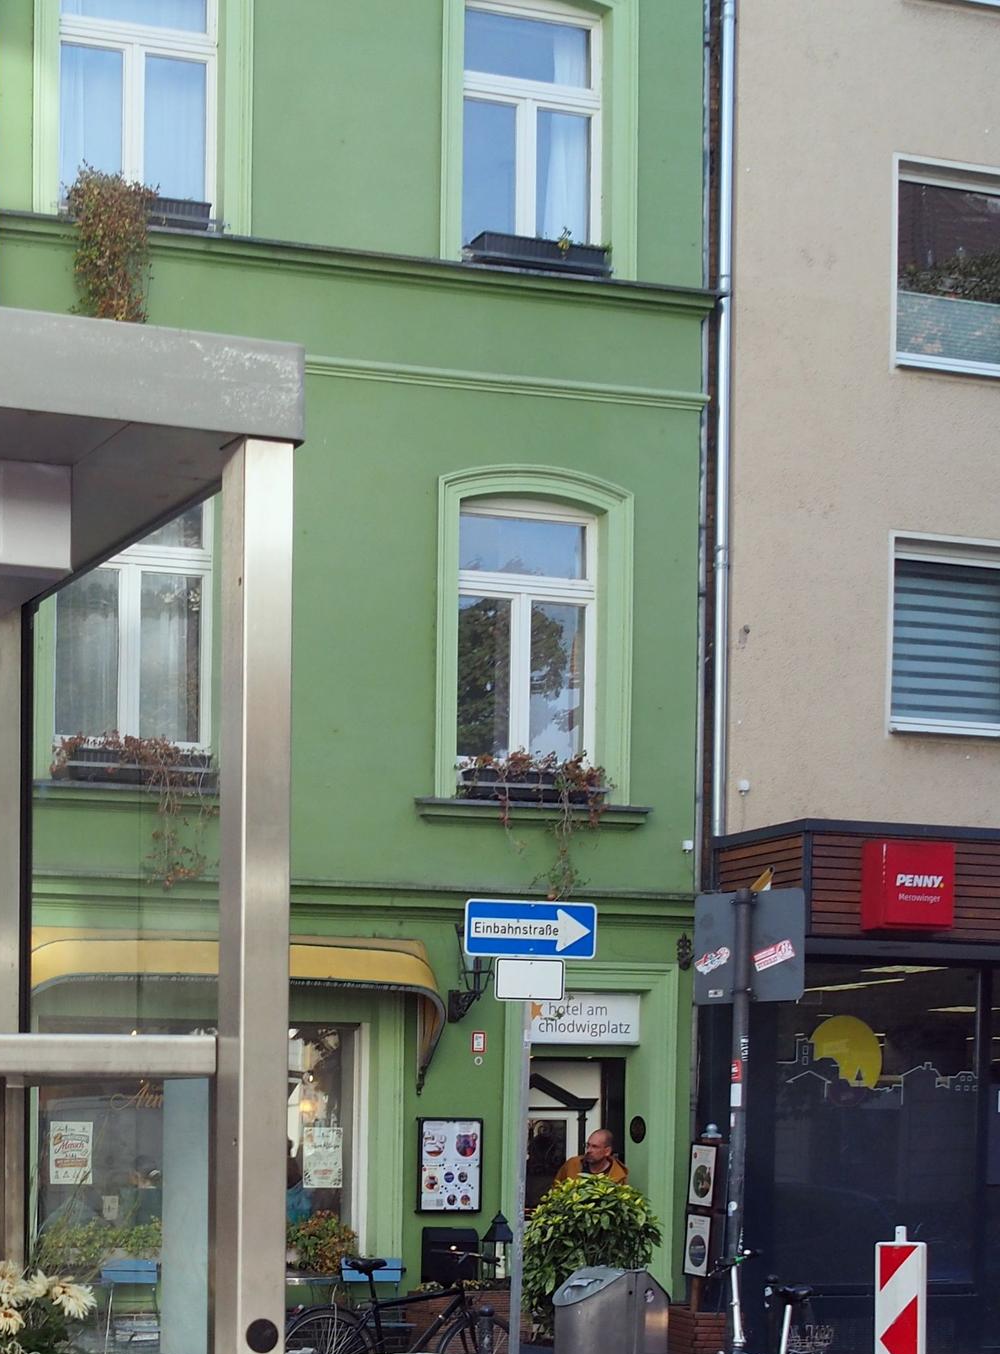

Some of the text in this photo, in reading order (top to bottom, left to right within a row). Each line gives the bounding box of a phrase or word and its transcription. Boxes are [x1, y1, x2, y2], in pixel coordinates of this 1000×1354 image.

[898, 892, 941, 904] Merowinger
[474, 921, 559, 937] Einbahnstraße
[548, 1002, 608, 1016] hotel am
[538, 1020, 631, 1037] chlodwigplatz
